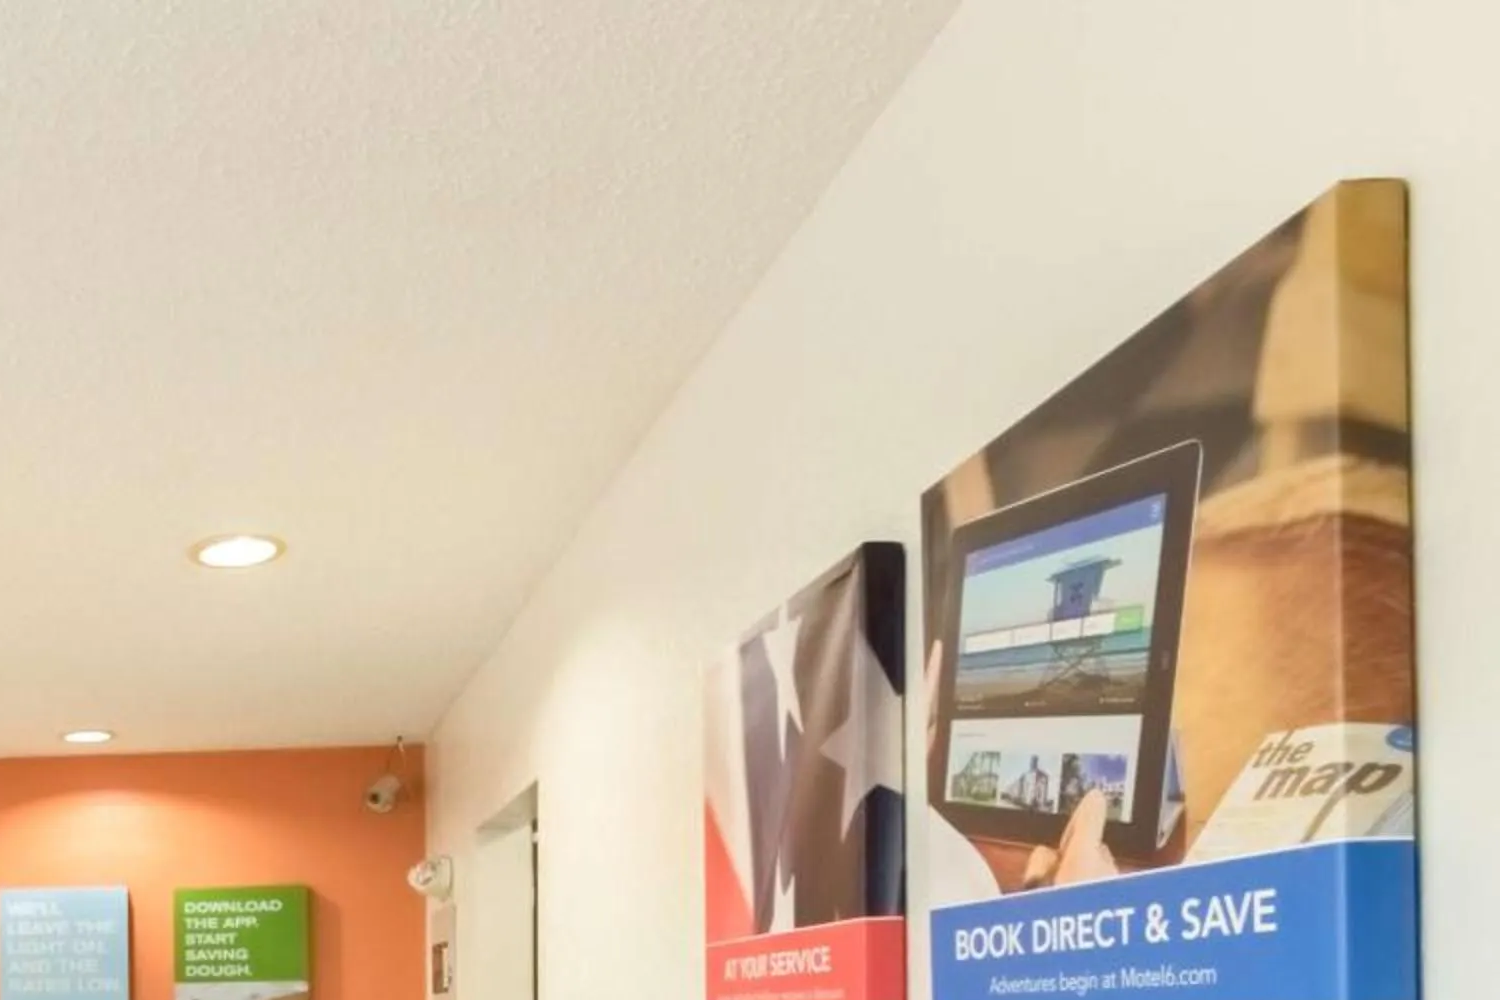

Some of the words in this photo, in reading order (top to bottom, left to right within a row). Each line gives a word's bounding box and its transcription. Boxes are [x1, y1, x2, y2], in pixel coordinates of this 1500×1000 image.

[1252, 729, 1314, 768] the
[1253, 762, 1403, 843] map
[184, 898, 283, 914] DOWNLOAD
[7, 919, 69, 935] LEAVE
[74, 919, 116, 935] THE
[184, 916, 218, 929] THE
[222, 915, 259, 929] APP.
[954, 921, 1026, 961] BOOK
[1032, 908, 1135, 951] DIRECT
[1145, 903, 1169, 943] &
[1181, 888, 1278, 939] SAVE
[184, 932, 239, 946] START
[7, 940, 65, 955] LIGHT
[184, 947, 250, 961] SAVING
[7, 959, 52, 974] AND
[55, 958, 99, 973] THE
[185, 964, 253, 977] DOUGH.
[723, 957, 741, 981] AT
[740, 953, 768, 980] YOUR
[770, 945, 832, 977] SERVICE
[988, 974, 1056, 995] Adventures
[1059, 971, 1098, 997] begin
[1102, 972, 1116, 989] at
[1120, 963, 1217, 988] Motel6.com
